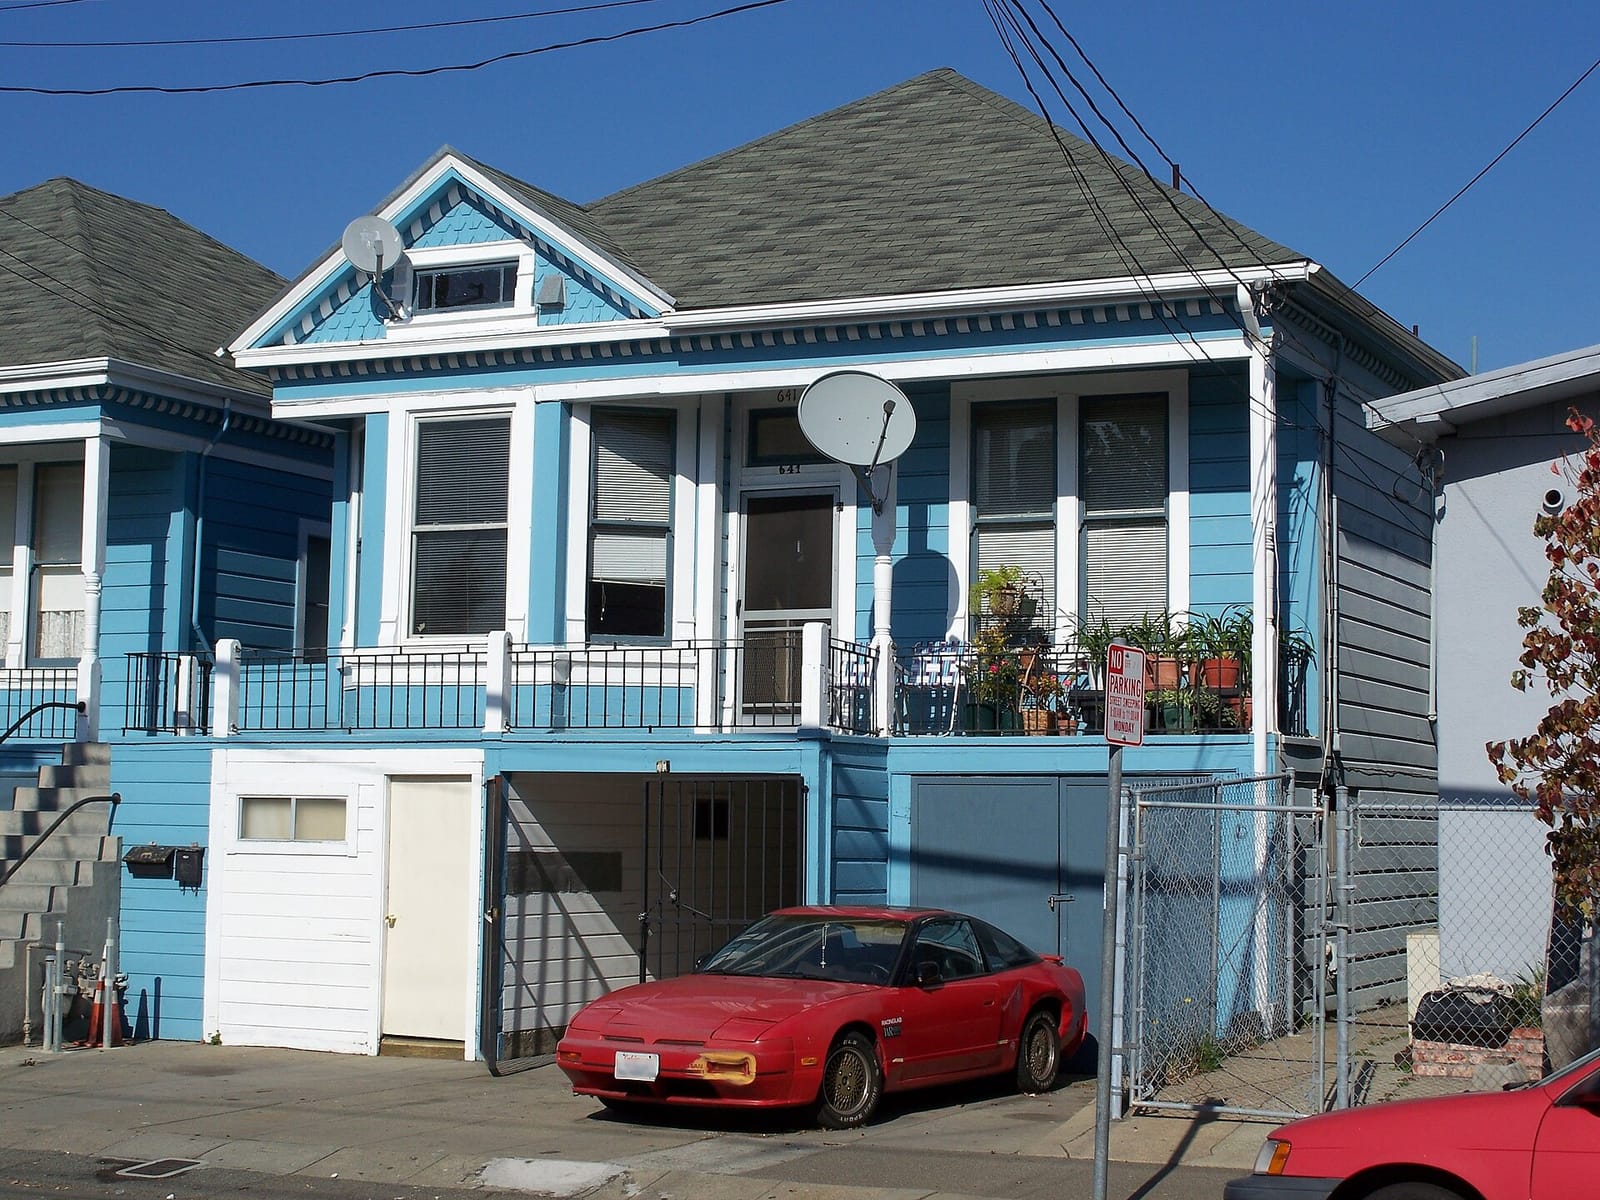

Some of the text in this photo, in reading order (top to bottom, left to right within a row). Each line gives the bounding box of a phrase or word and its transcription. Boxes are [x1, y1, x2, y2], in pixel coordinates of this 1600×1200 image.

[777, 389, 797, 402] 641
[779, 464, 801, 474] 641
[1111, 650, 1122, 669] NO
[1110, 675, 1141, 697] PARKING
[1113, 720, 1135, 733] MONDAY
